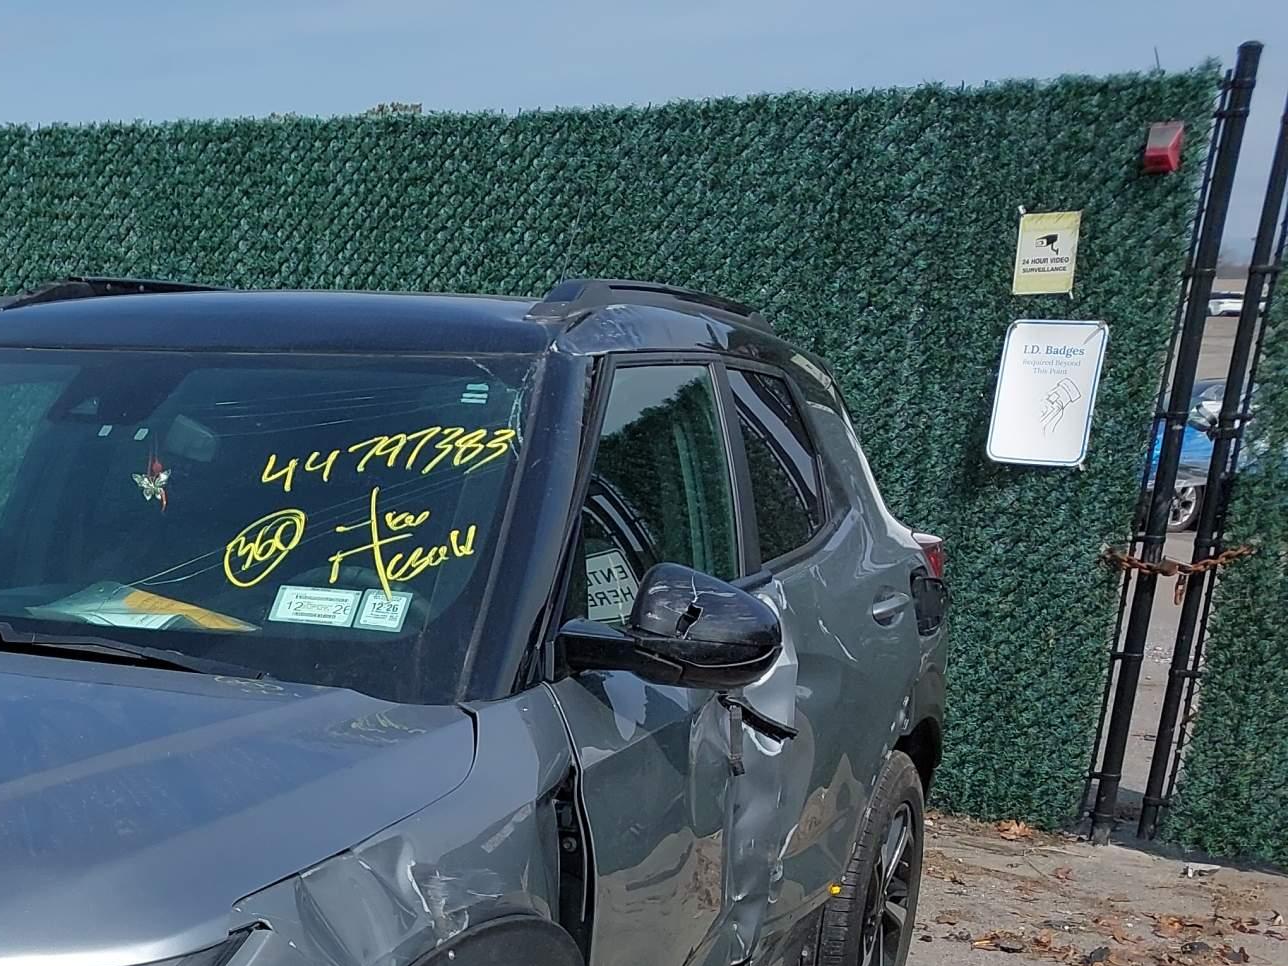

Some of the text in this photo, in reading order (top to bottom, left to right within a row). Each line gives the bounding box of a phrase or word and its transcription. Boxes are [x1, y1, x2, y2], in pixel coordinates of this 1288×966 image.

[1031, 257, 1049, 265] HOUR
[1050, 256, 1070, 264] VIDEO
[1022, 265, 1067, 274] SURVEILLANCE
[1023, 344, 1086, 358] I.D. Badges
[1050, 367, 1068, 375] Point
